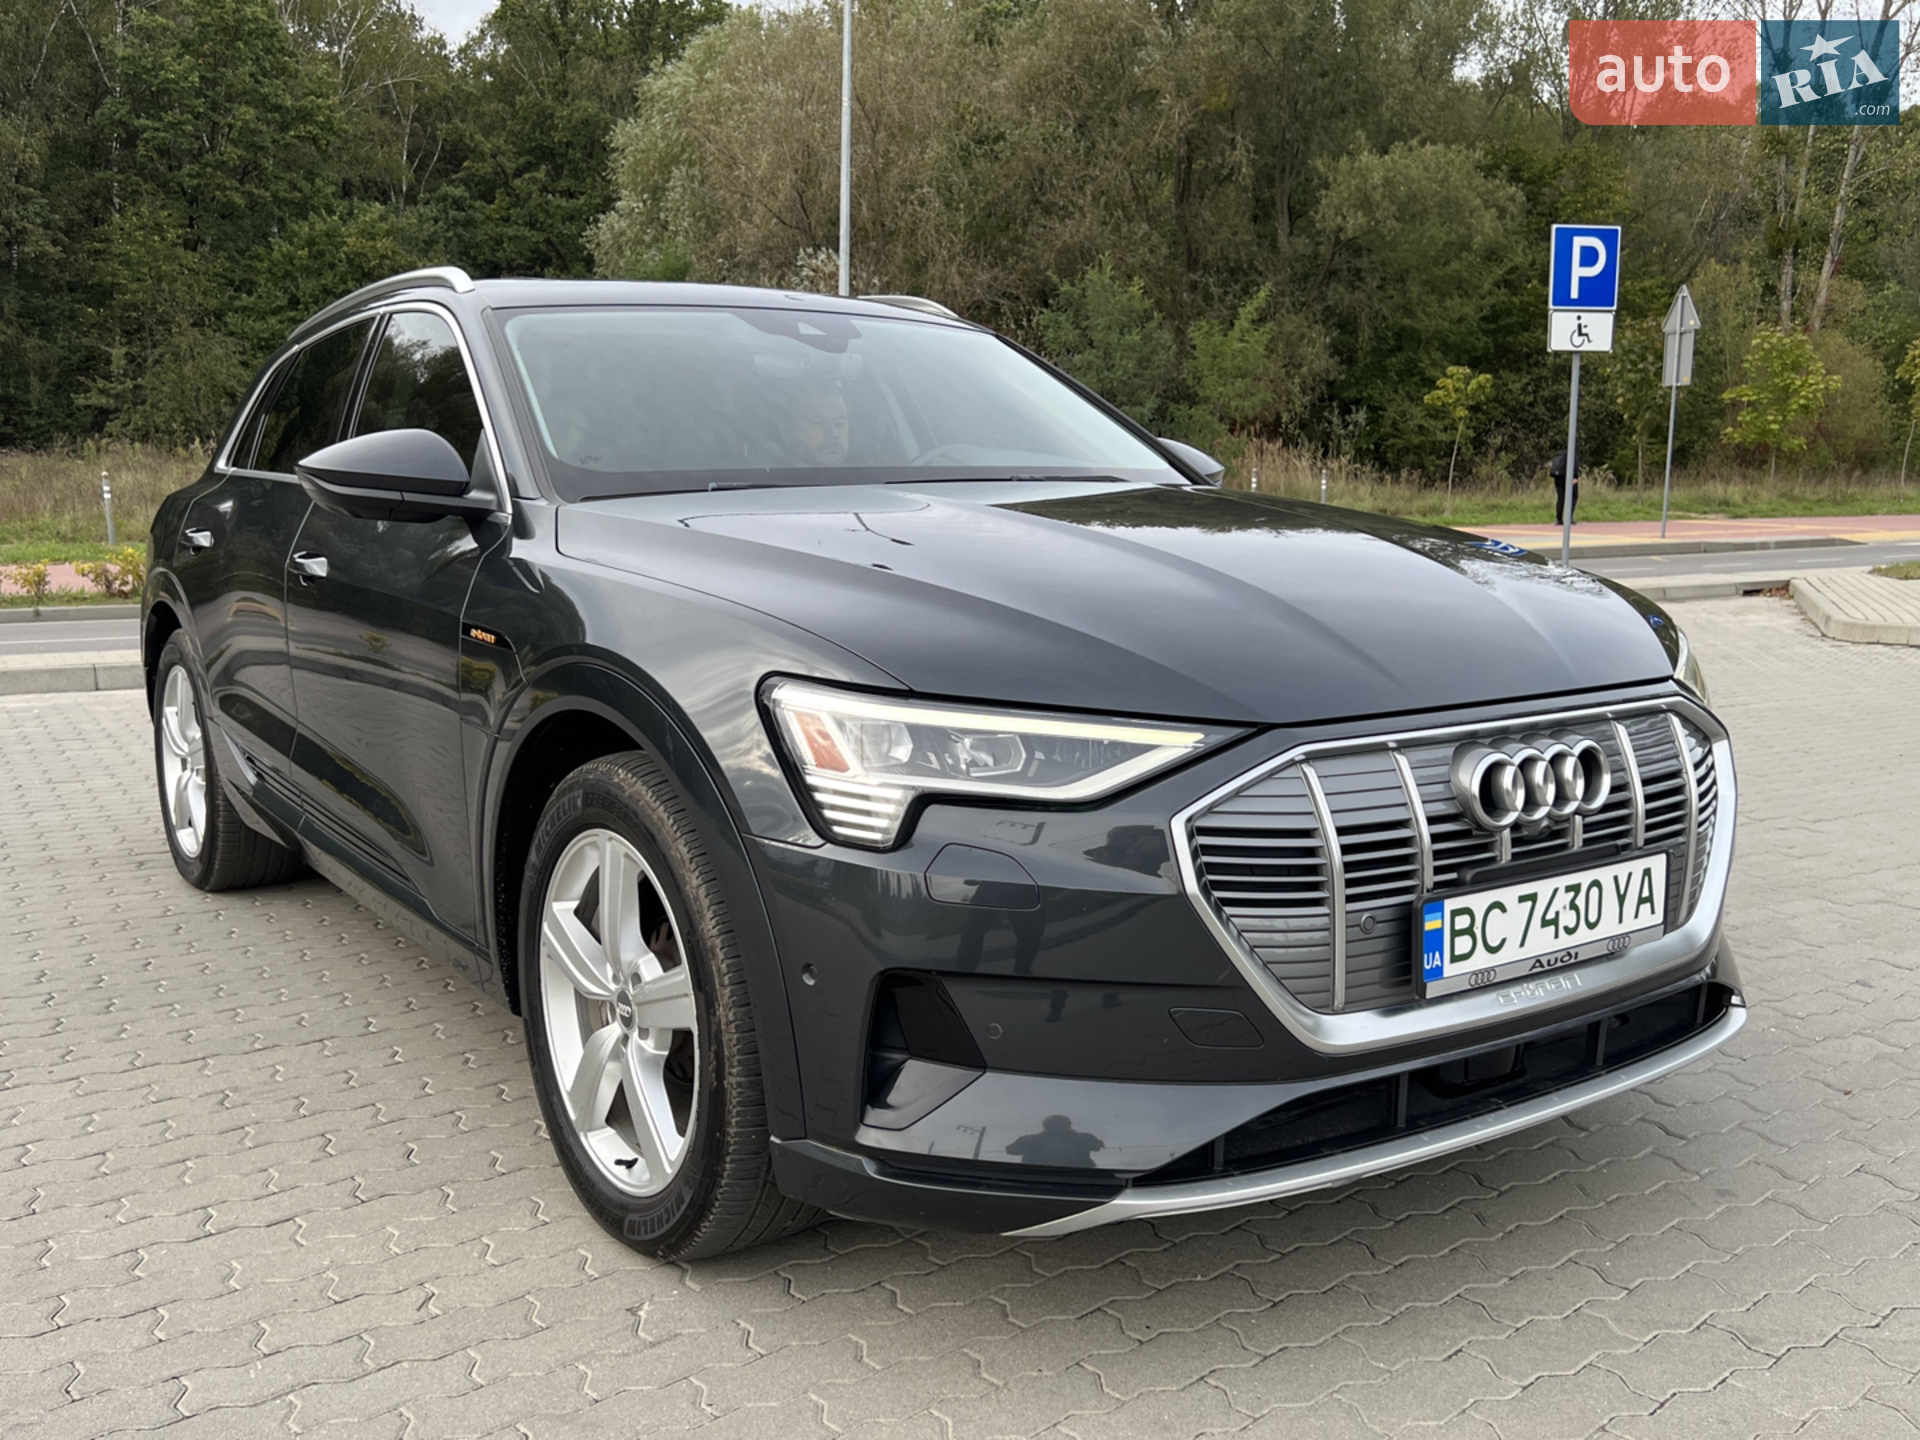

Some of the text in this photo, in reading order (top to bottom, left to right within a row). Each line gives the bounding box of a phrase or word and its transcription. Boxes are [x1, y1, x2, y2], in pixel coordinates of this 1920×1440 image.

[1570, 235, 1607, 299] P
[534, 793, 583, 860] MICHELIN
[1424, 951, 1442, 970] UA
[1528, 950, 1579, 972] Audi
